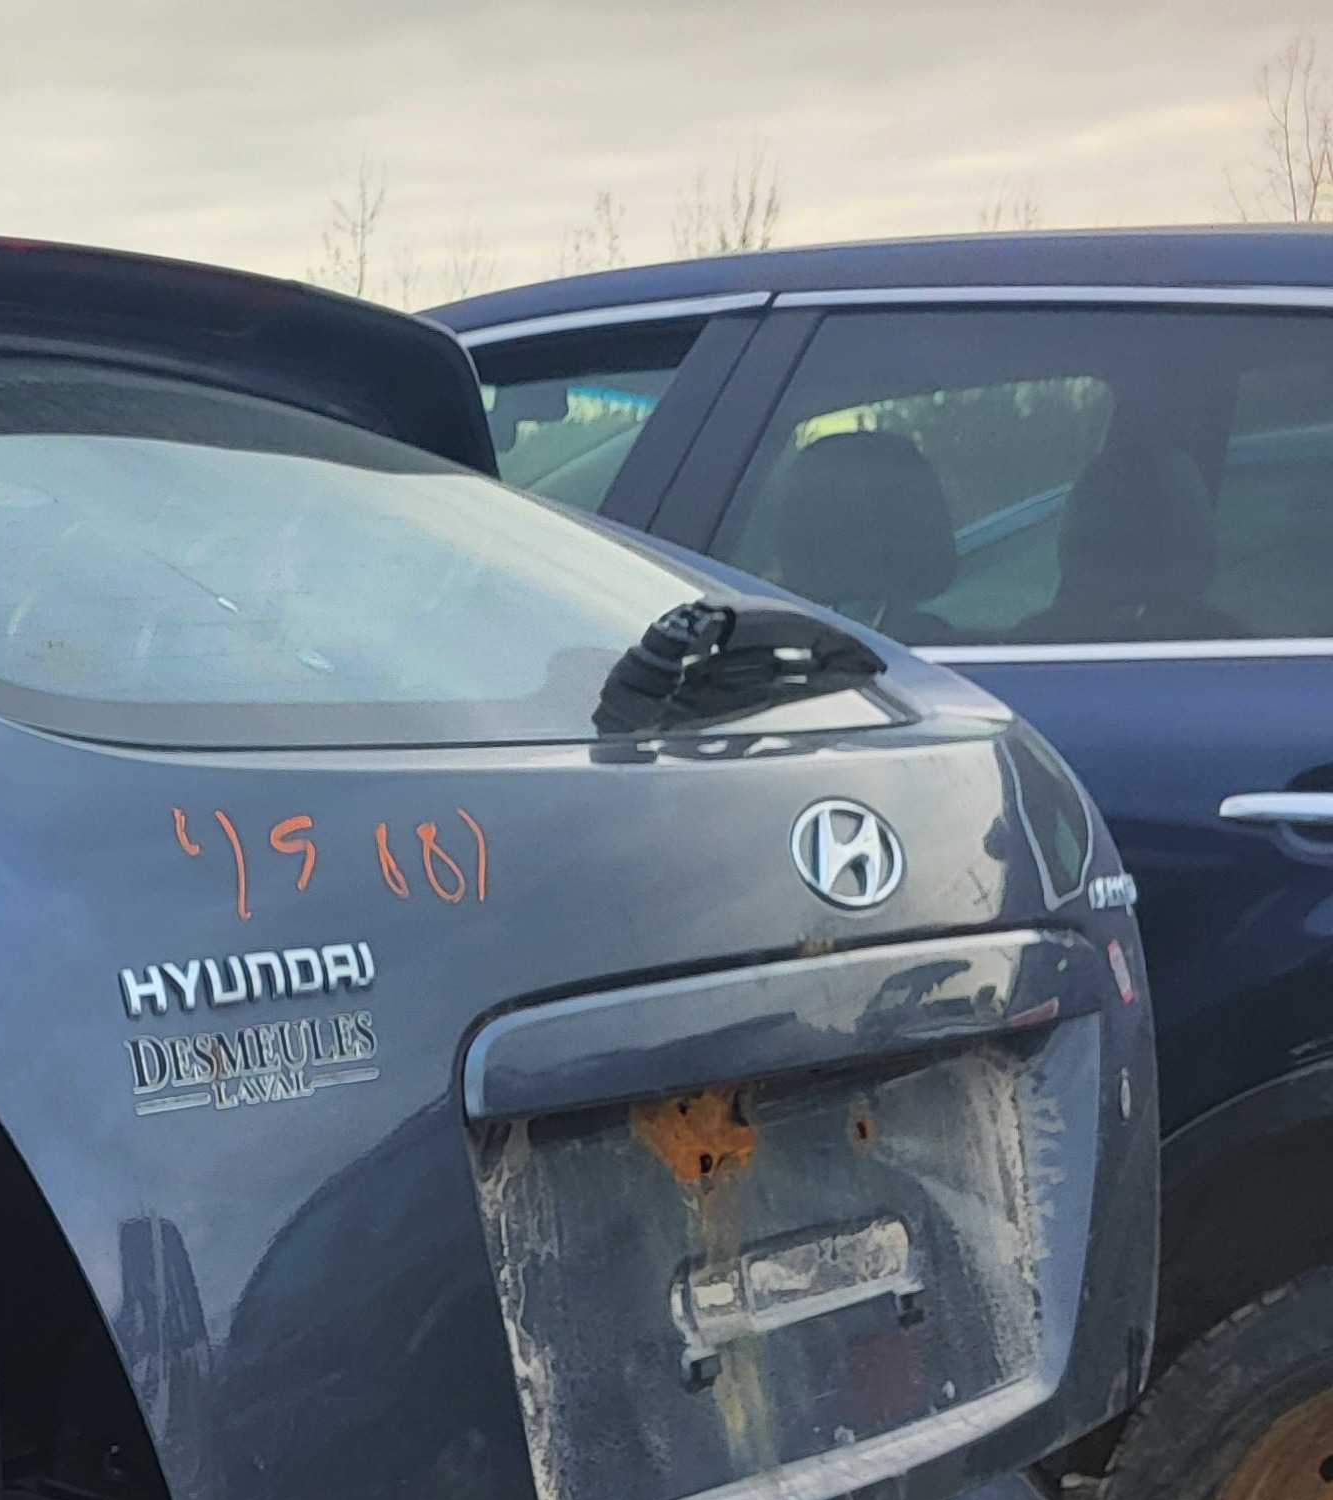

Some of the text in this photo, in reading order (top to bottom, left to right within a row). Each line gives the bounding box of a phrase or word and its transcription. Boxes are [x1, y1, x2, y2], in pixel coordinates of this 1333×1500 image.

[119, 941, 376, 1017] HYUNDAI
[124, 1011, 379, 1095] DESMEULES
[210, 1069, 316, 1110] LAVAL
